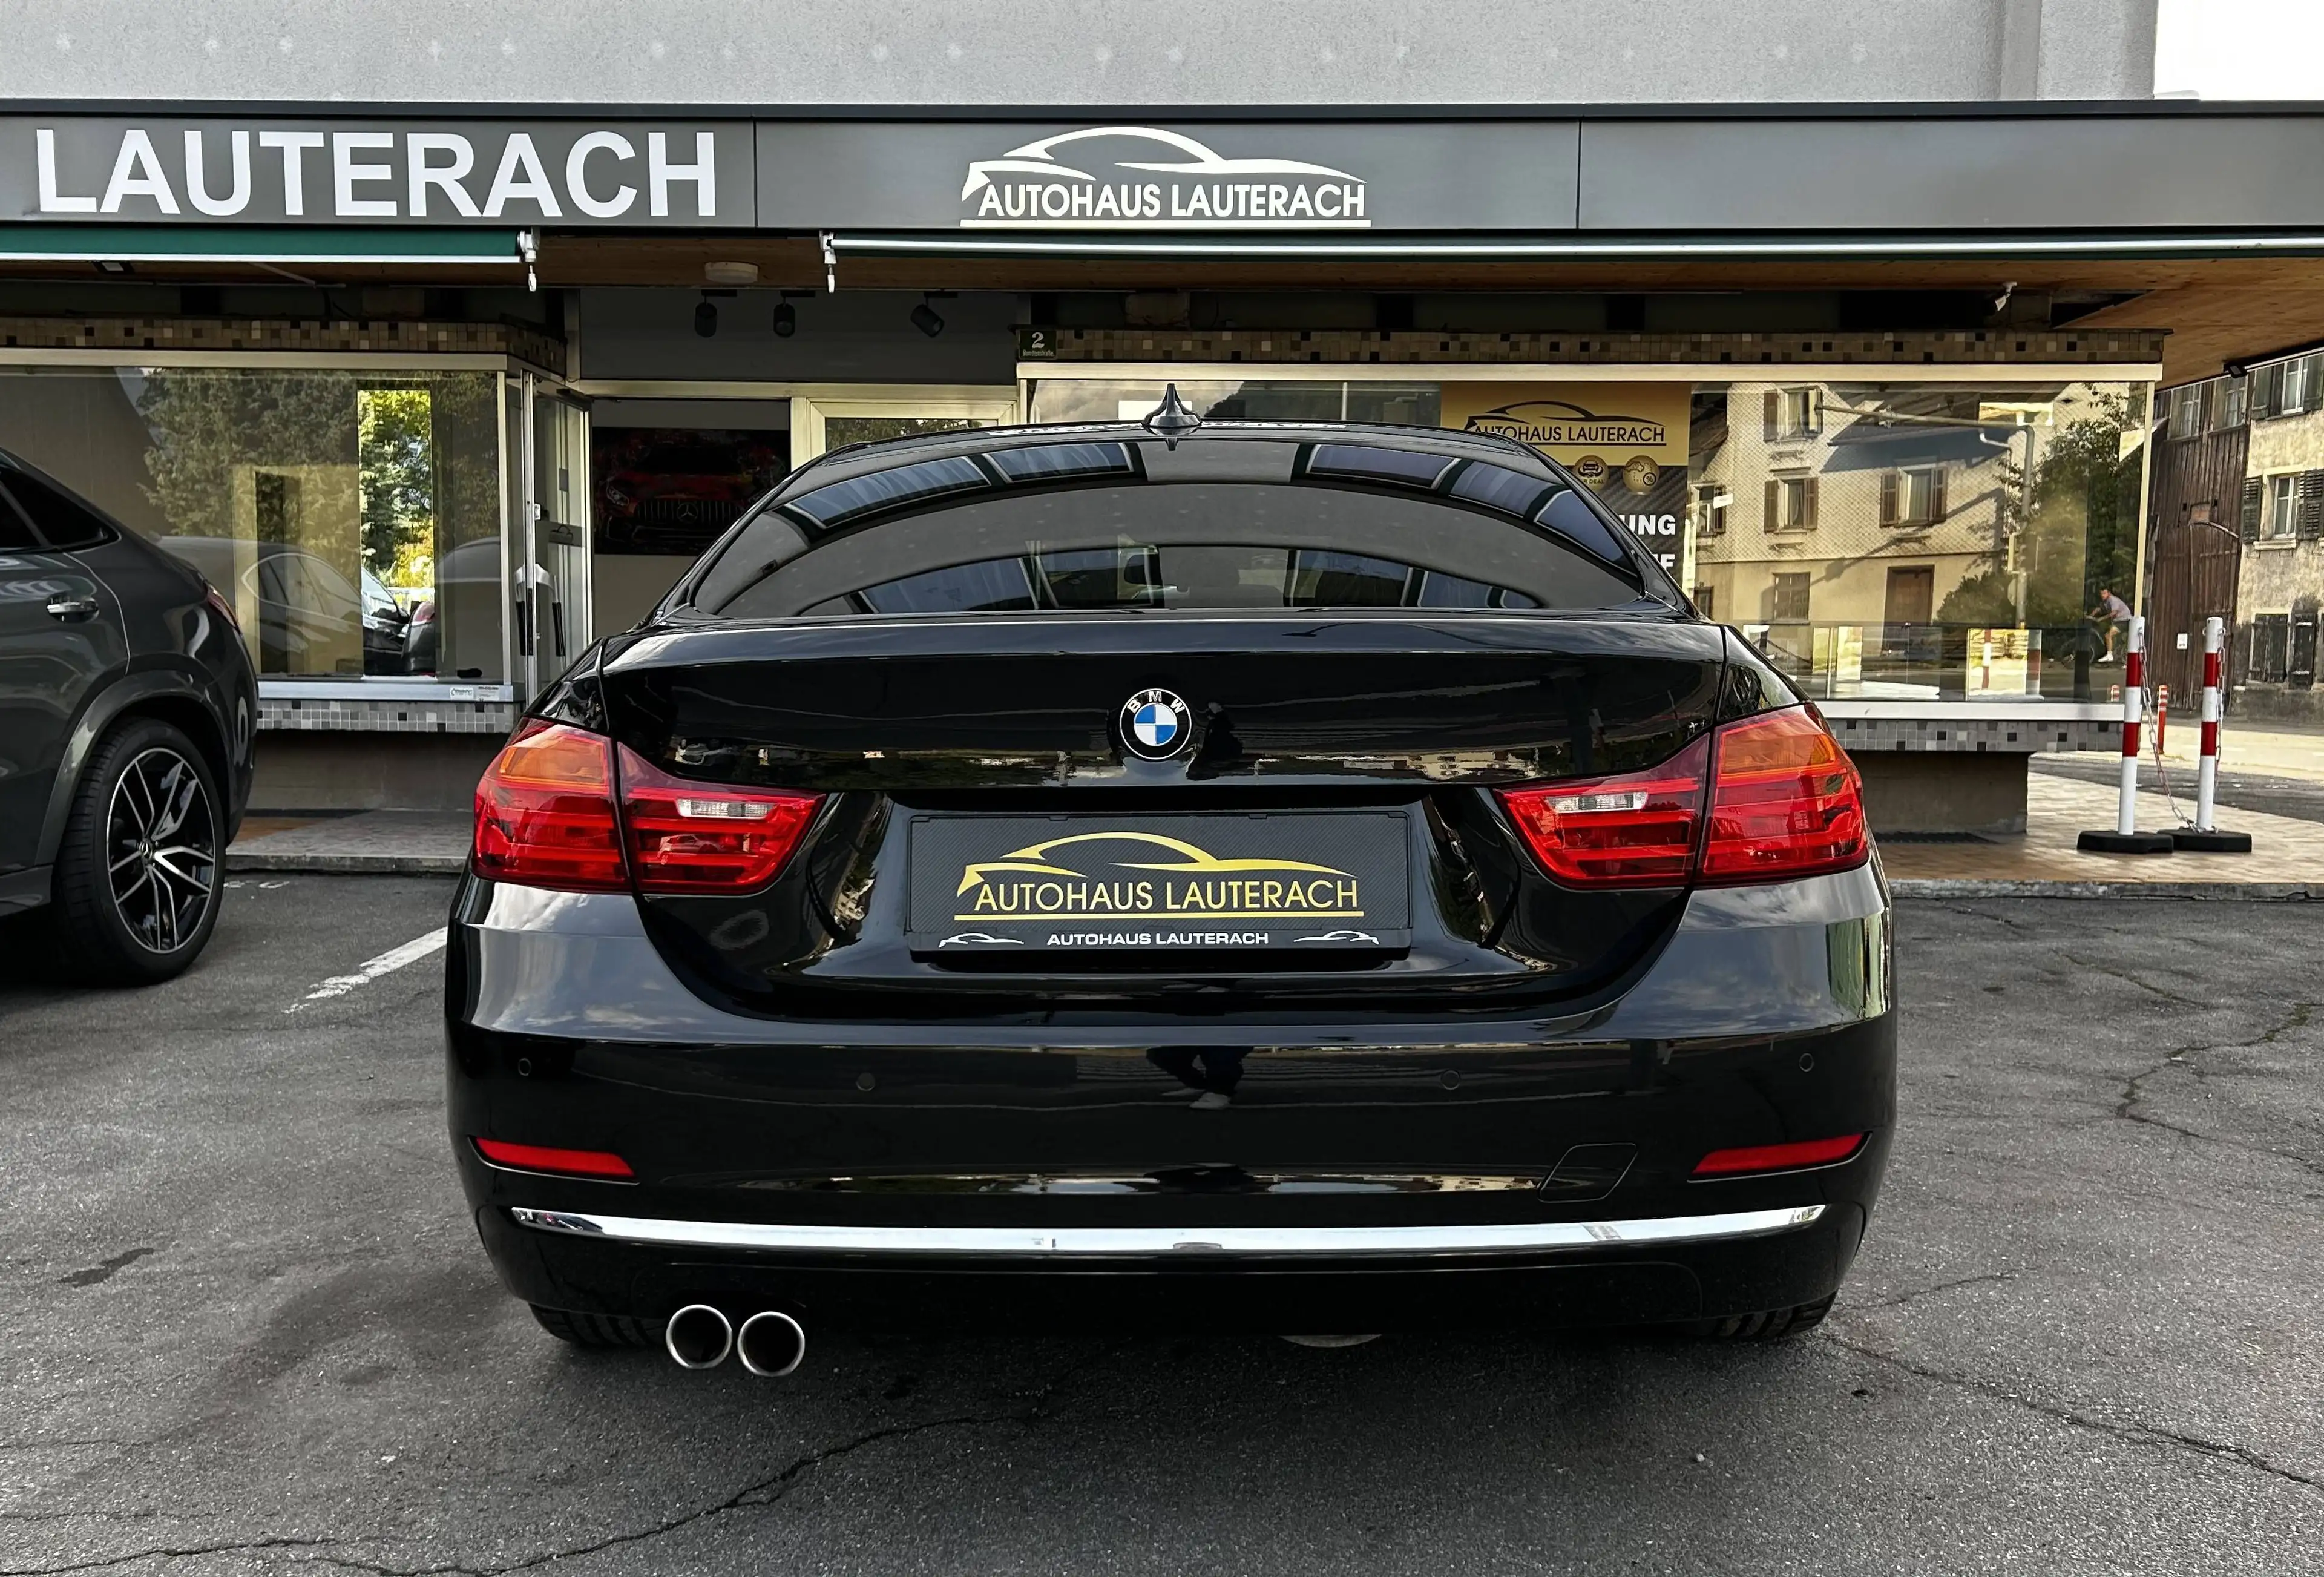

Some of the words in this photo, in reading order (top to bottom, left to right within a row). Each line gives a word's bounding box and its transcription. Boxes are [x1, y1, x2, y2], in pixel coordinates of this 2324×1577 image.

[36, 129, 716, 217] LAUTERACH
[977, 184, 1161, 217] AUTOHAUS
[1172, 184, 1365, 217] LAUTERACH
[1032, 332, 1045, 349] 2
[1568, 426, 1664, 442] LAUTERACH
[1127, 690, 1186, 714] BMW
[974, 881, 1153, 912] AUTOHAUS
[1166, 880, 1357, 910] LAUTERACH
[1047, 933, 1152, 946] AUTOHAUS
[1155, 932, 1269, 945] LAUTERACH
